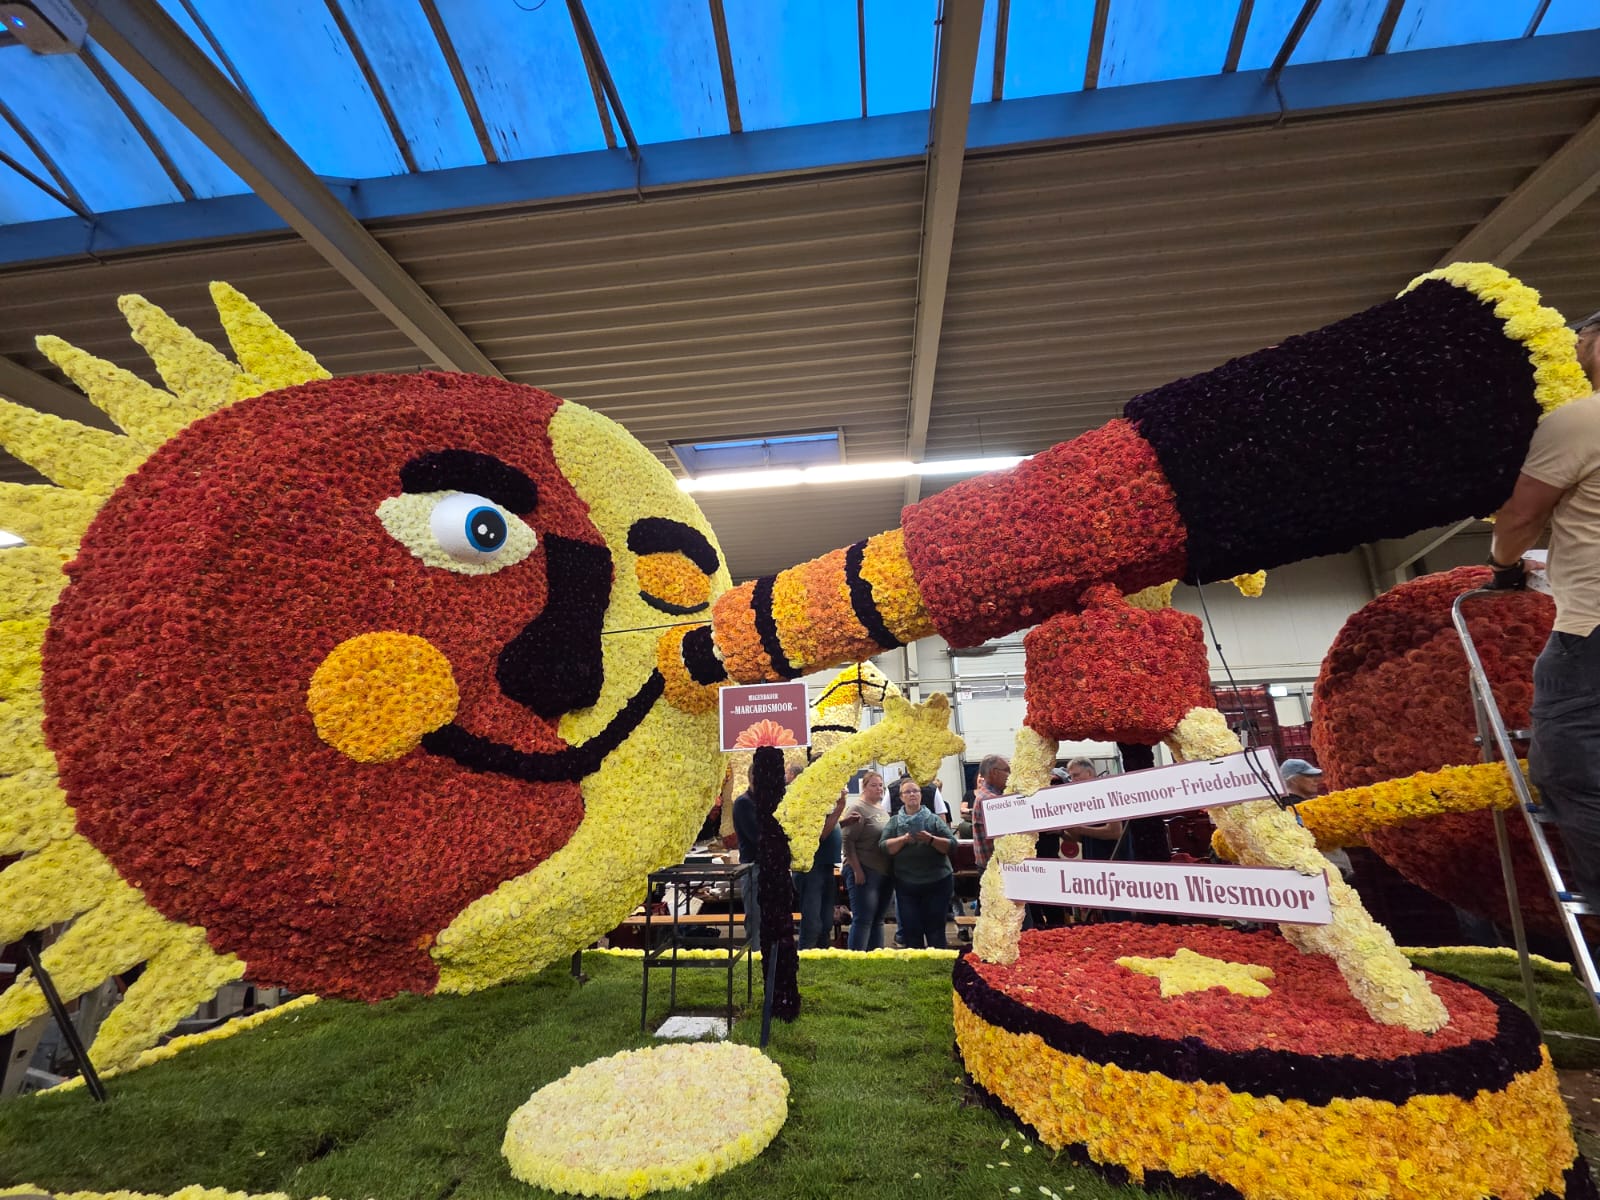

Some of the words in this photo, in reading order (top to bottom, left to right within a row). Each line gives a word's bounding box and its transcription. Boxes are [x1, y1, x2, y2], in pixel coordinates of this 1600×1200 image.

[1031, 795, 1106, 820] Imkerverein
[1031, 865, 1047, 874] von:
[1059, 869, 1180, 902] Landfrauen
[1184, 875, 1316, 910] Wiesmoor
